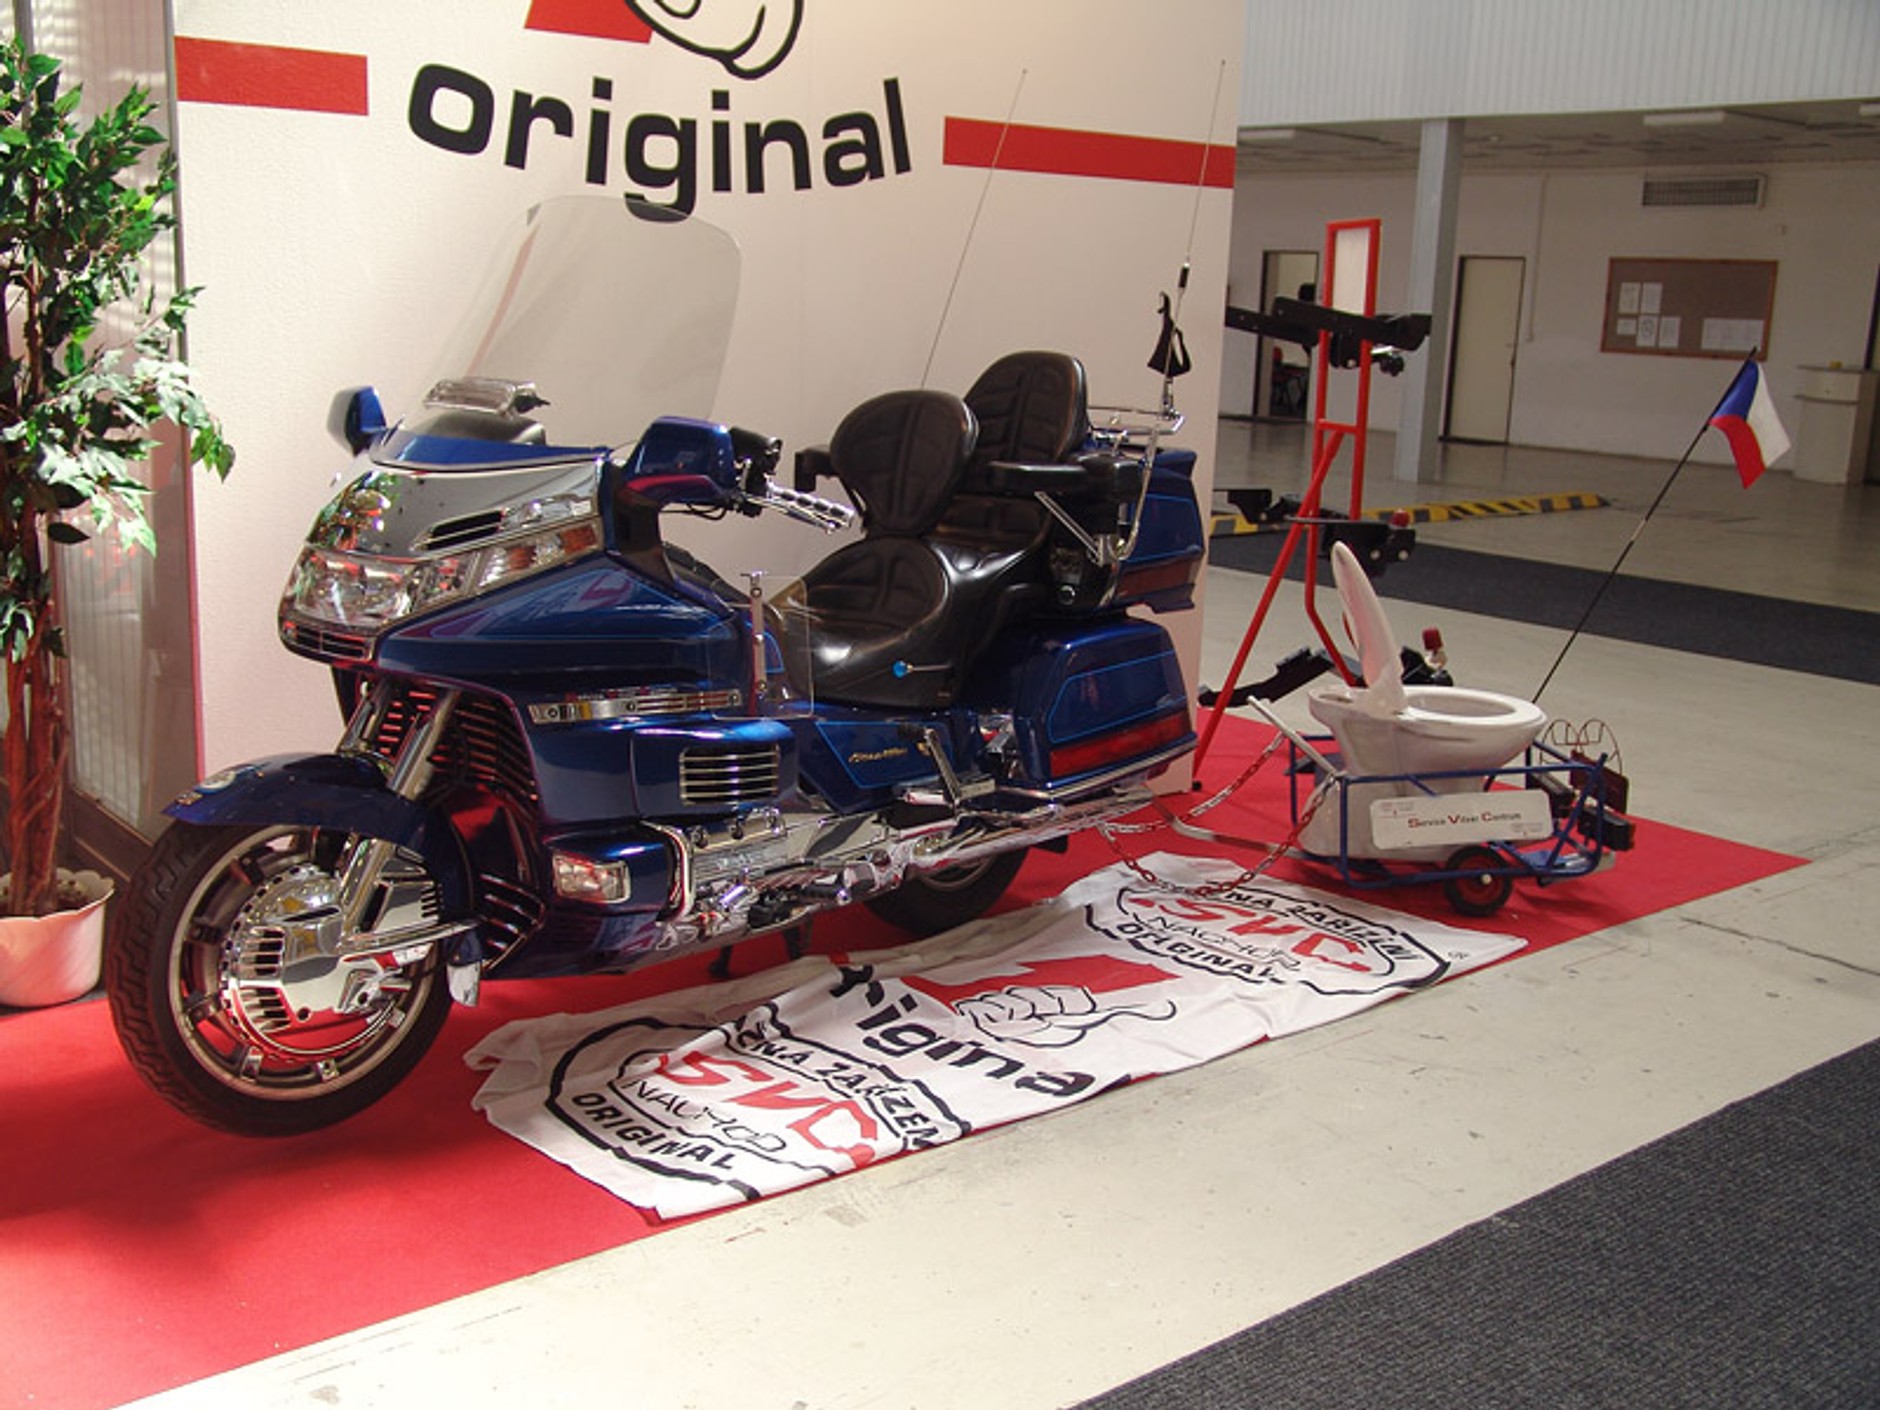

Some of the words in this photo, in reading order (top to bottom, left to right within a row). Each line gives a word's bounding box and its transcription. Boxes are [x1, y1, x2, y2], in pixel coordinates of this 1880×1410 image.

[408, 64, 912, 224] original
[1128, 898, 1373, 972] SVC
[571, 1091, 736, 1171] ORIGINAL
[655, 1050, 879, 1168] SVC
